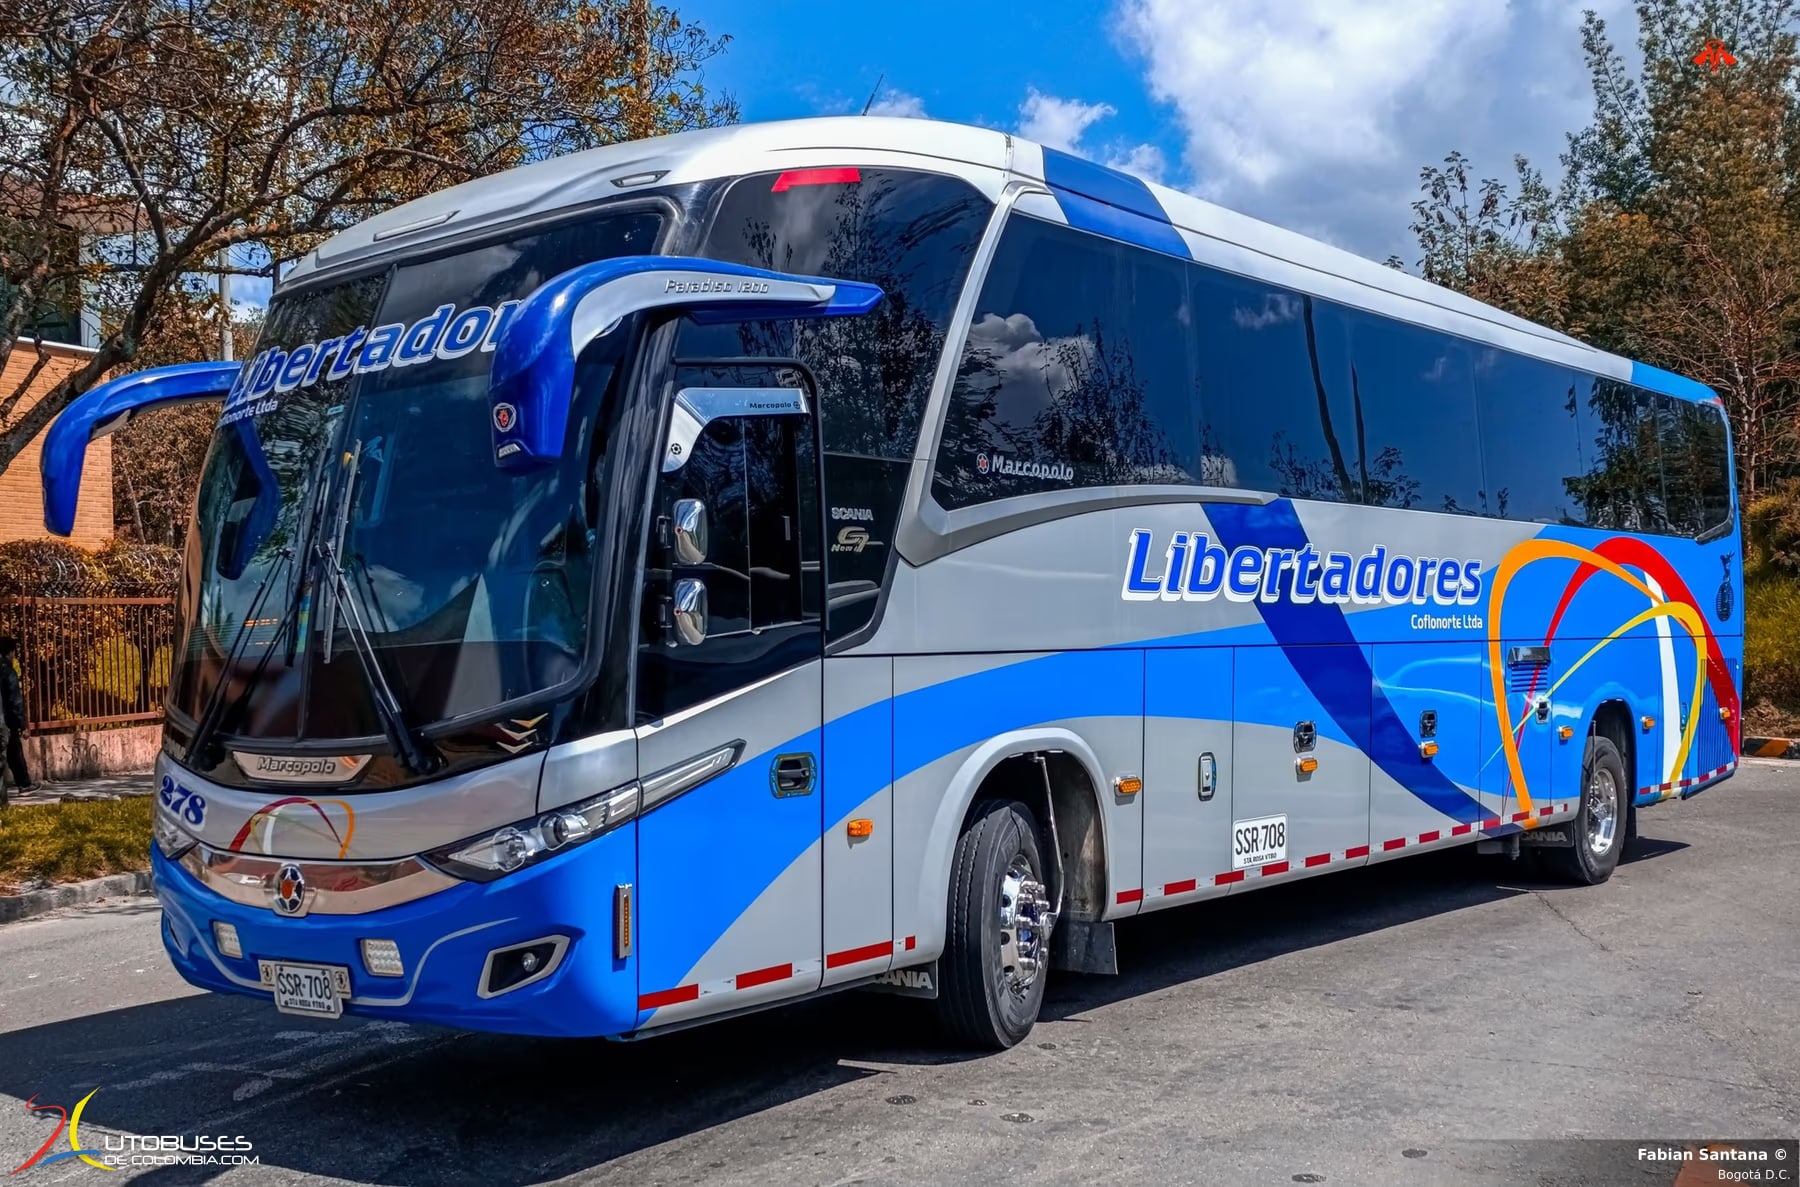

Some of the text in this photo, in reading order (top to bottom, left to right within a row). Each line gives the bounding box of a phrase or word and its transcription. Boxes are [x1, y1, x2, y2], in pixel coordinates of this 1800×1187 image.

[664, 277, 769, 294] Paradiso 1200
[255, 399, 278, 415] Ltda
[749, 401, 792, 409] Marcopolo
[992, 455, 1074, 480] Marcopolo
[831, 507, 874, 521] SCANIA
[1121, 528, 1482, 605] Libertadores
[1411, 614, 1483, 630] Coflonorte Ltda
[257, 757, 336, 773] Marcopolo
[160, 774, 206, 826] 278
[1520, 831, 1567, 842] CANIA
[884, 970, 933, 990] ANIA
